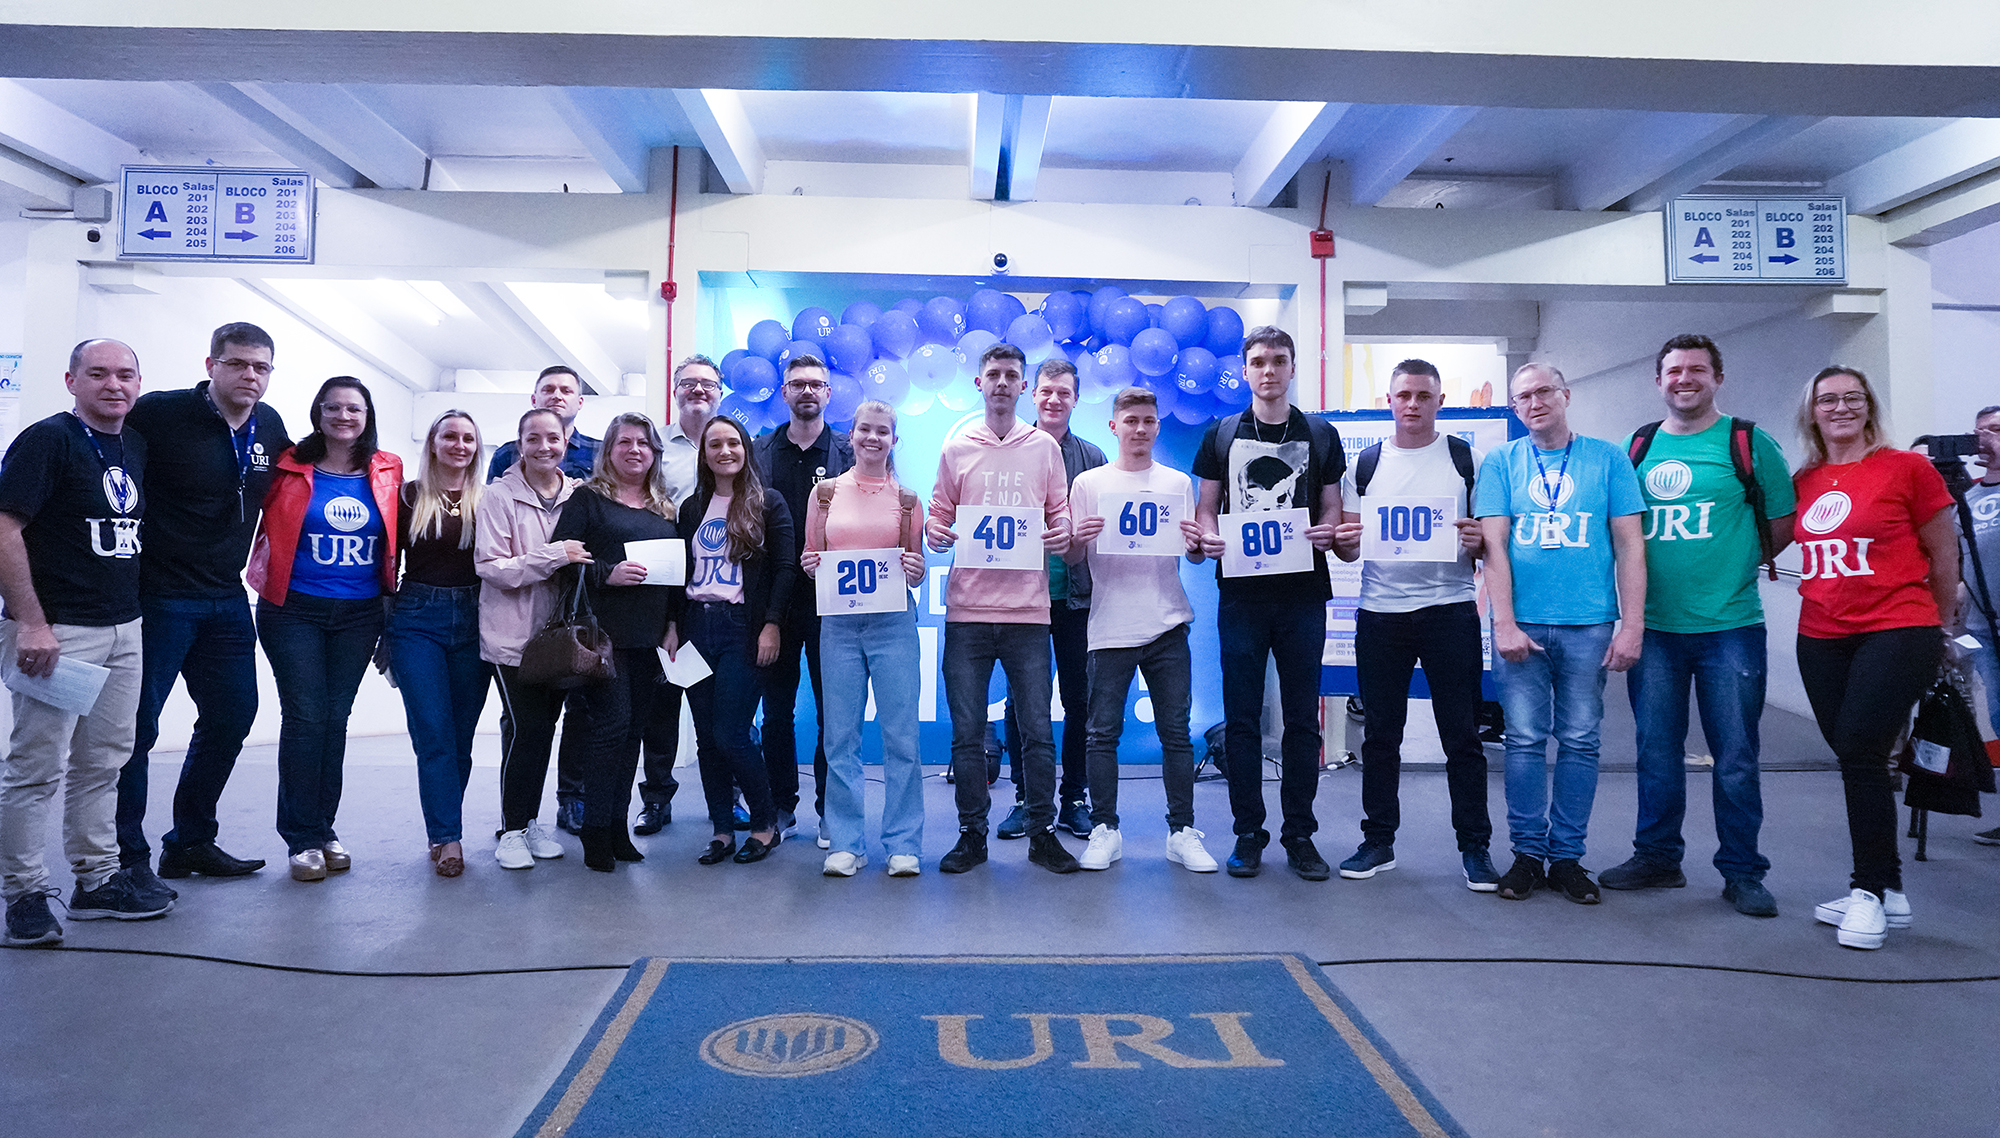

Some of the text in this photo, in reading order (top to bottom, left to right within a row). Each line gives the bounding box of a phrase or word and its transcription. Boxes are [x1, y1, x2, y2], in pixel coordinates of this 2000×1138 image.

[272, 177, 304, 186] Salas
[137, 185, 178, 195] BLOCO
[182, 182, 214, 191] Salas
[226, 187, 266, 197] BLOCO
[187, 194, 208, 202] 201
[276, 200, 297, 208] 202
[1808, 203, 1837, 211] Salas
[144, 201, 168, 222] A
[187, 205, 208, 213] 202
[235, 203, 255, 224] B
[1726, 209, 1755, 217] Salas
[186, 216, 207, 224] 203
[276, 212, 296, 220] 203
[1684, 212, 1722, 221] BLOCO
[1766, 213, 1804, 221] BLOCO
[275, 223, 296, 231] 204
[186, 228, 207, 236] 204
[275, 234, 296, 242] 205
[1694, 227, 1715, 247] A
[1776, 228, 1796, 248] B
[186, 239, 207, 247] 205
[274, 246, 295, 254] 206
[1814, 246, 1834, 254] 204
[1733, 252, 1752, 260] 204
[1733, 263, 1753, 271] 205
[1816, 268, 1835, 276] 206
[817, 327, 834, 336] UR
[869, 365, 886, 378] URI
[1218, 370, 1232, 389] URI
[732, 408, 749, 425] URI
[250, 454, 269, 466] URI
[982, 472, 1024, 487] THE
[982, 490, 1022, 506] END
[1120, 502, 1170, 536] 60%
[1378, 506, 1443, 541] 100%
[973, 516, 1027, 550] 40%
[1515, 512, 1592, 548] URI
[85, 518, 142, 558] UR
[1242, 521, 1293, 557] 80%
[308, 533, 378, 566] URI
[837, 559, 888, 595] 20%
[920, 1012, 1286, 1070] URI
